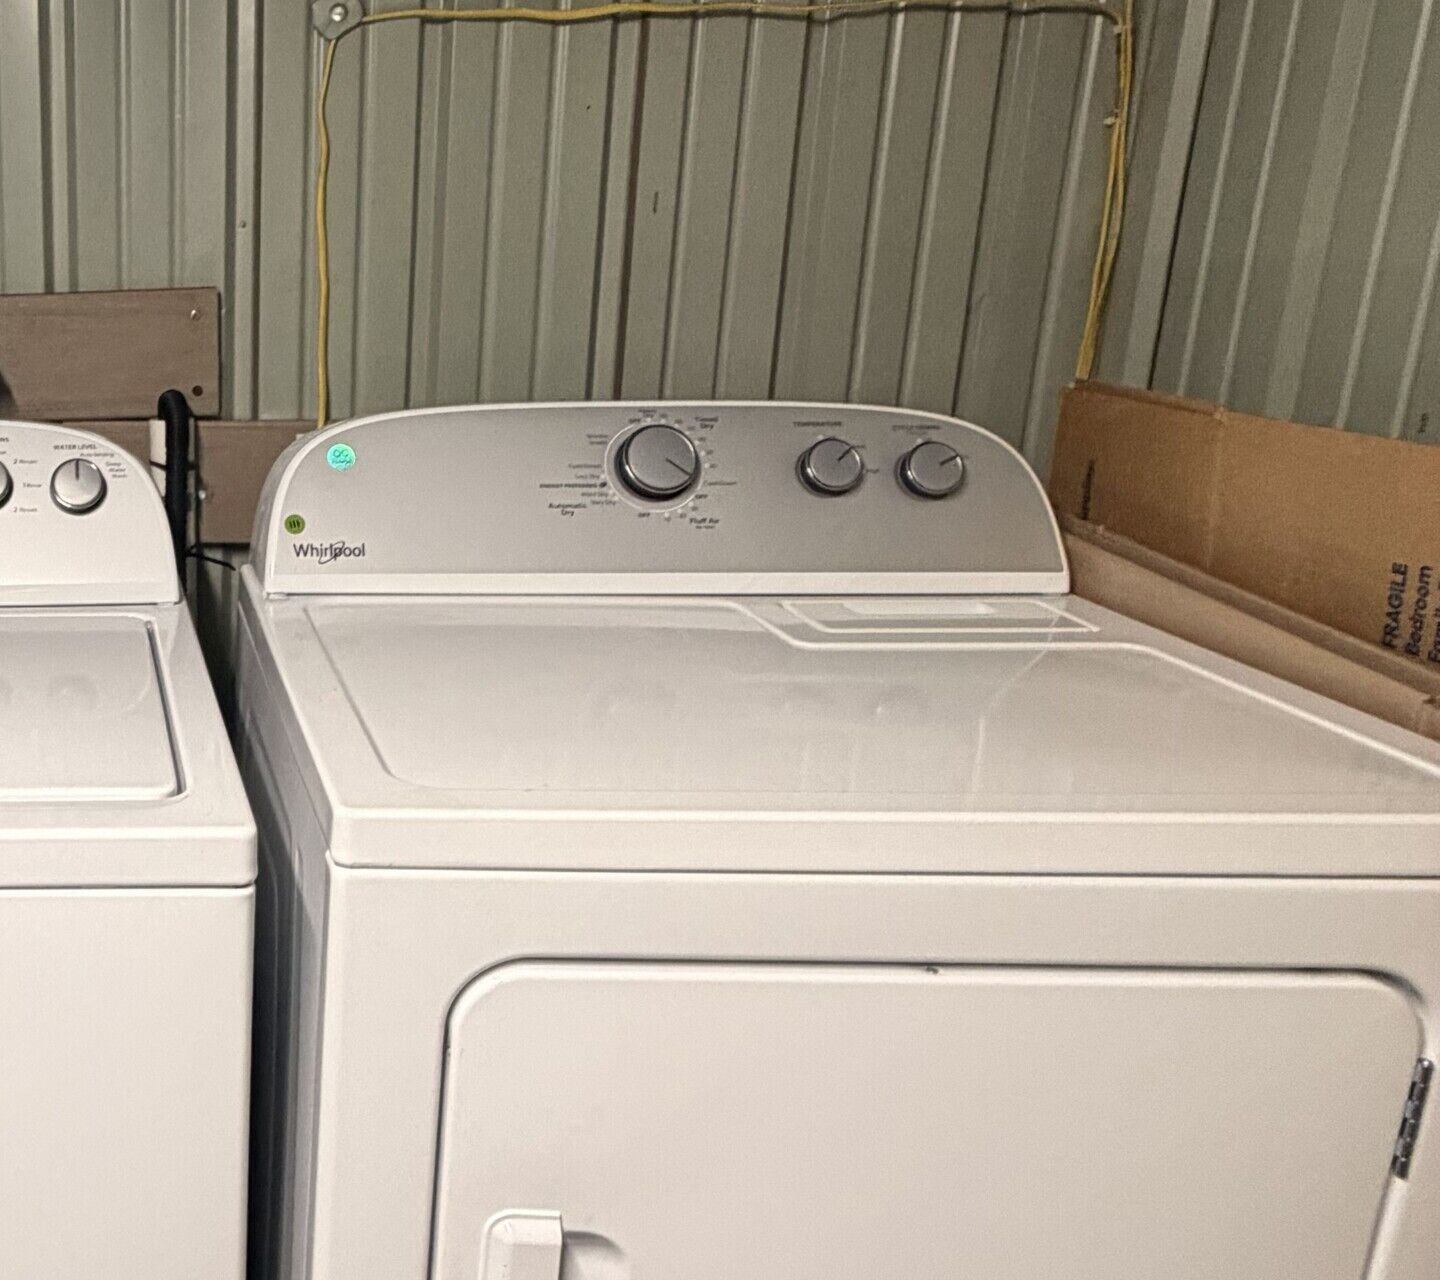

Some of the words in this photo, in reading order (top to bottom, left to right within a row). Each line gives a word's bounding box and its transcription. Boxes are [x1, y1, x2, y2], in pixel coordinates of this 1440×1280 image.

[292, 541, 365, 562] Whirlpool
[1381, 562, 1408, 649] FRAGILE
[1404, 566, 1433, 656] Bedroom
